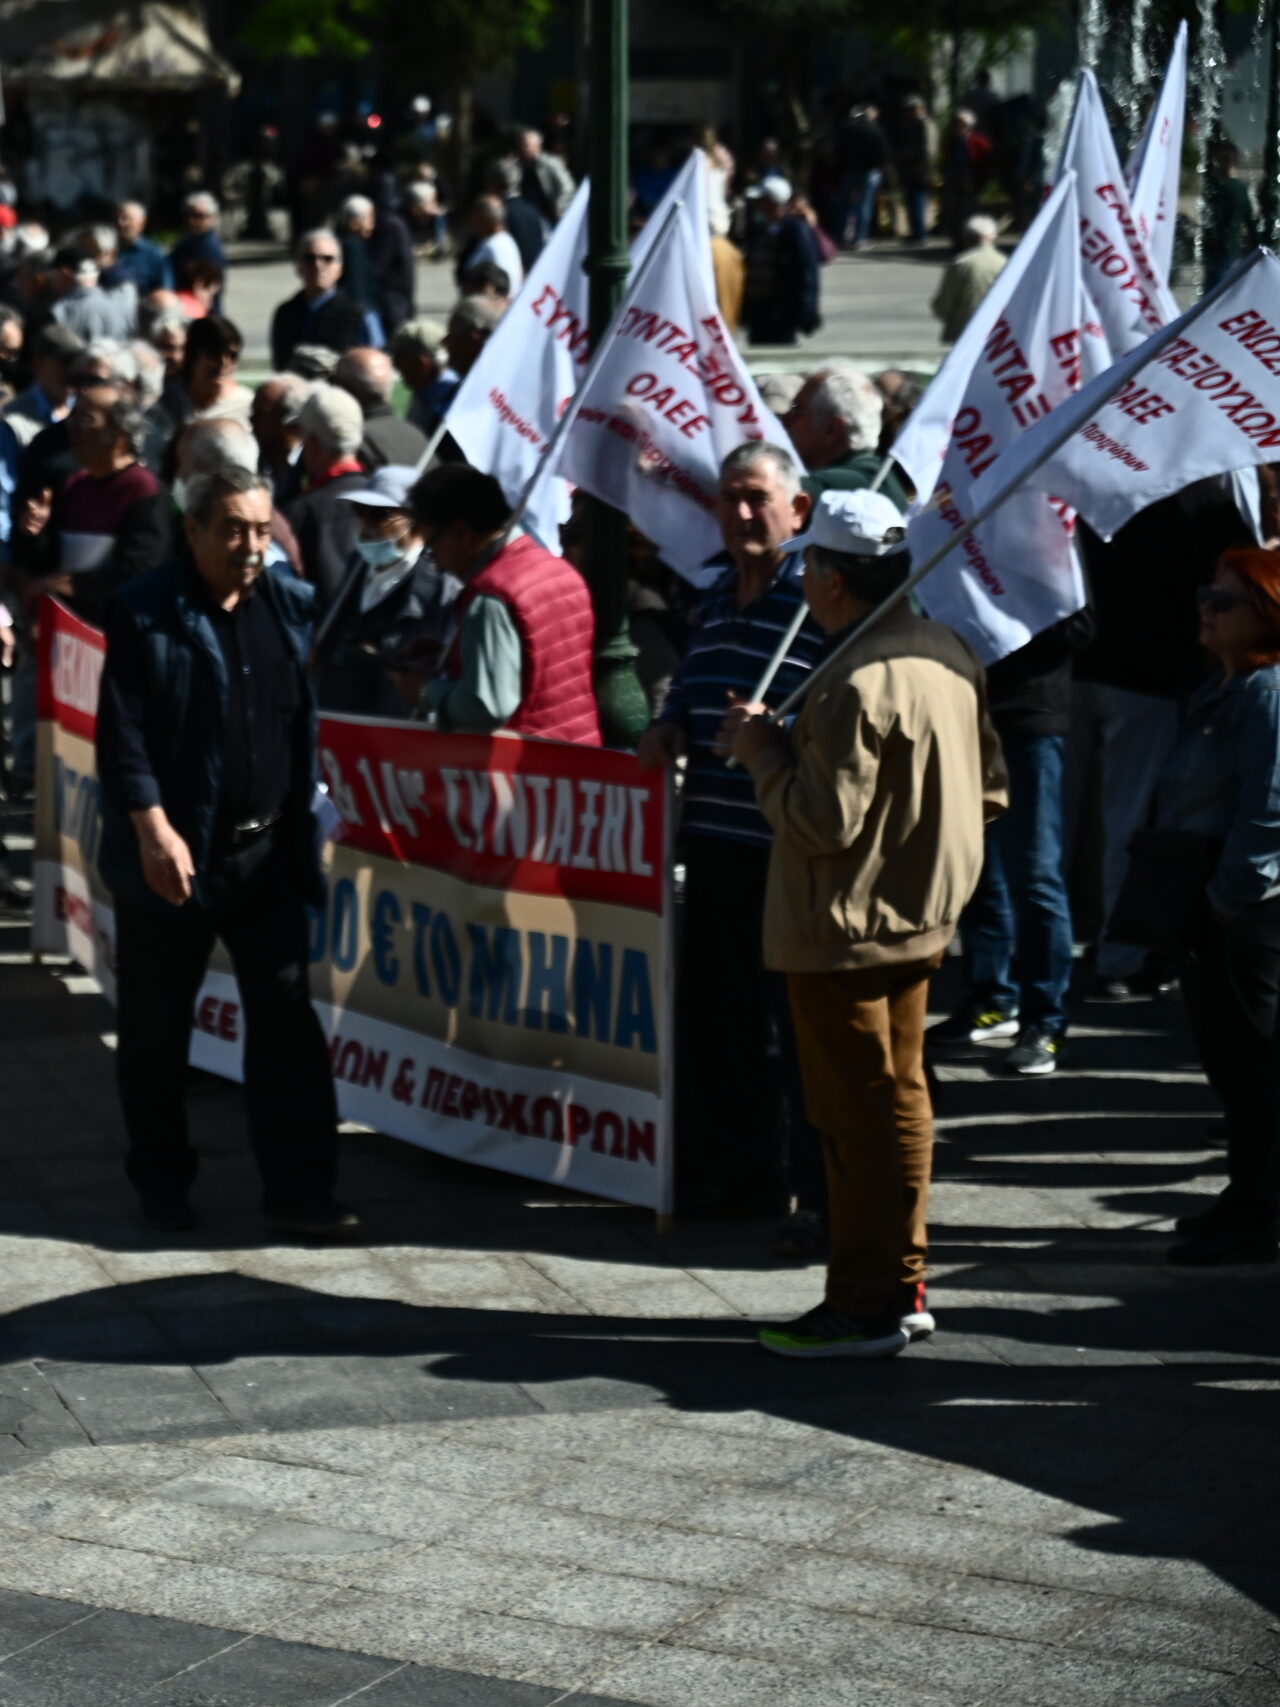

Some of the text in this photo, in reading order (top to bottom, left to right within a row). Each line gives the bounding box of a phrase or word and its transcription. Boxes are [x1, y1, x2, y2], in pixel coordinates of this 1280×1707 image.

[625, 371, 713, 439] ΟΑΕΕ
[936, 480, 1005, 597] Περιώρων
[440, 767, 655, 878] ΣΥΝΤΑΞΗΣ
[372, 889, 402, 988] €
[412, 900, 462, 1010] ΤΟ
[465, 922, 658, 1054] ΜΗΝΑ
[391, 1056, 418, 1107] &
[421, 1066, 656, 1166] ΠΕΡΙΧΩΡΩΝ
